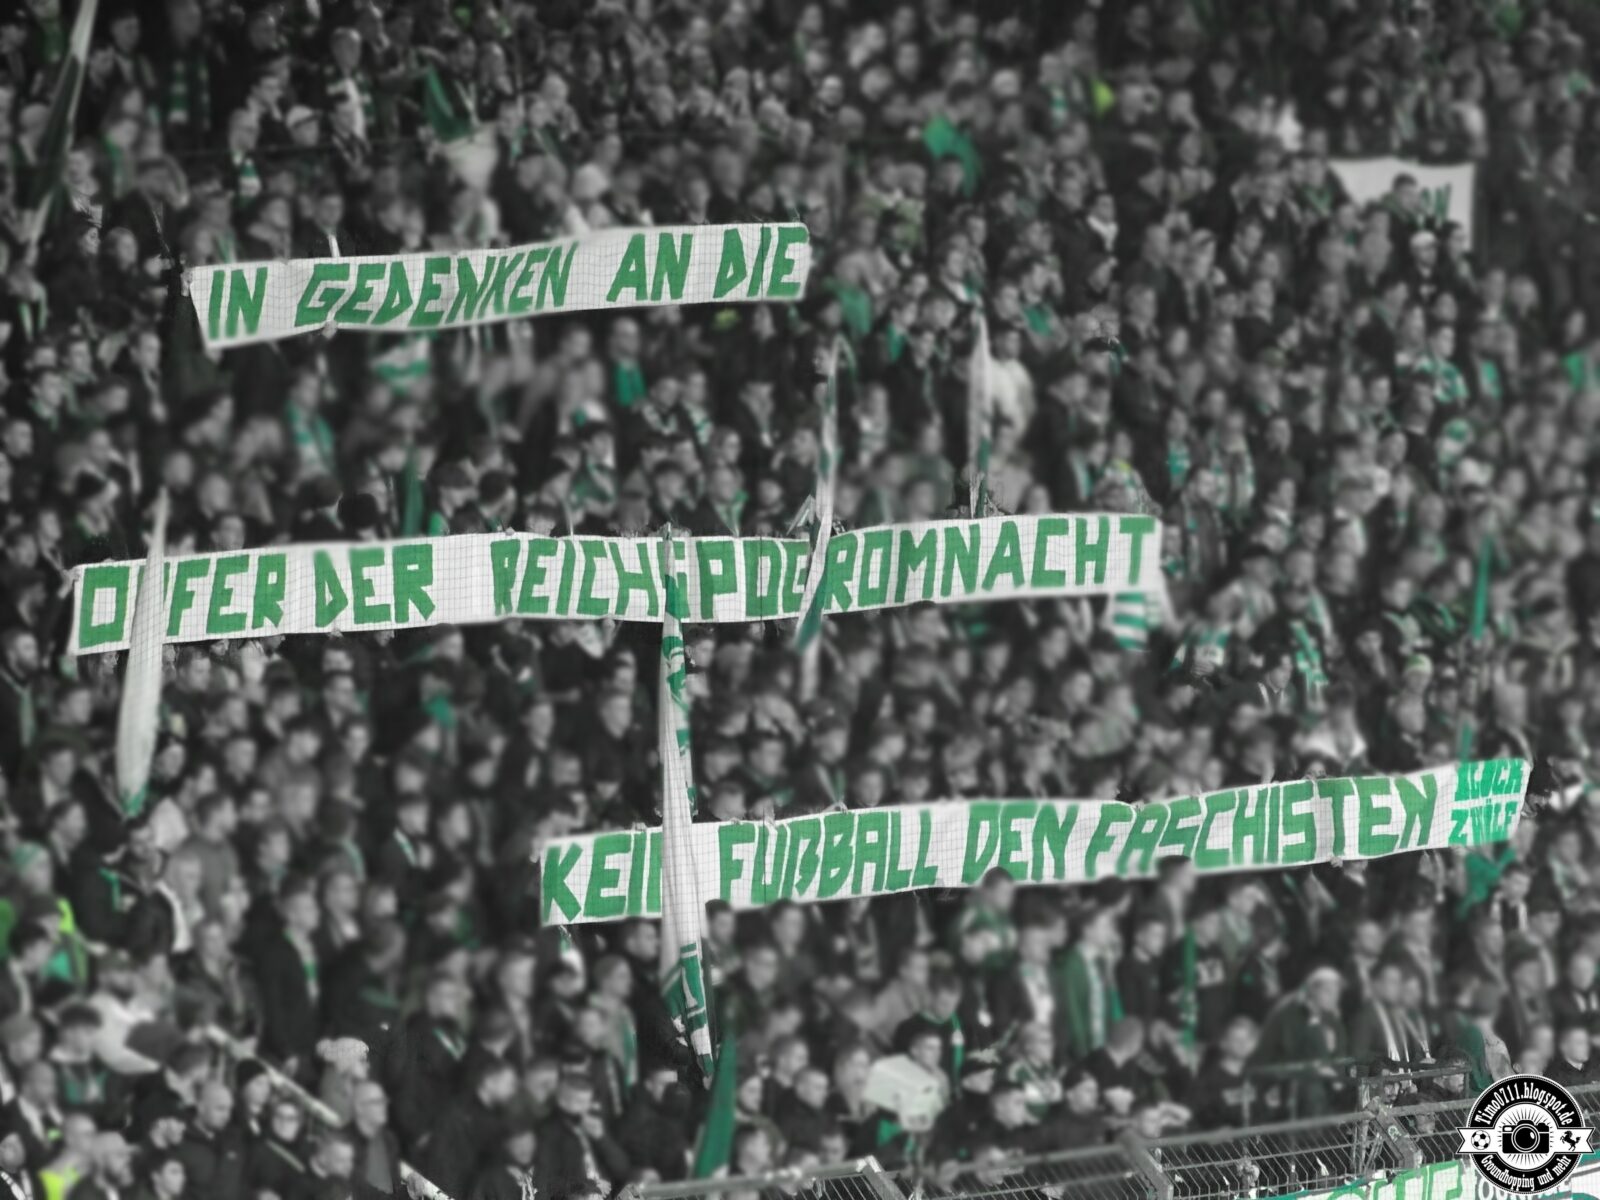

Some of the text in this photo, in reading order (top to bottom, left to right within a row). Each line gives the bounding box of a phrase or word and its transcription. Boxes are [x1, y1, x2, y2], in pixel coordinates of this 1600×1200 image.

[208, 226, 809, 340] IN GEDENKEN AN DIE
[79, 553, 287, 648] OFER
[313, 544, 436, 628] DER
[961, 803, 1079, 884] DEN
[1084, 773, 1437, 880] FASCHISTEN
